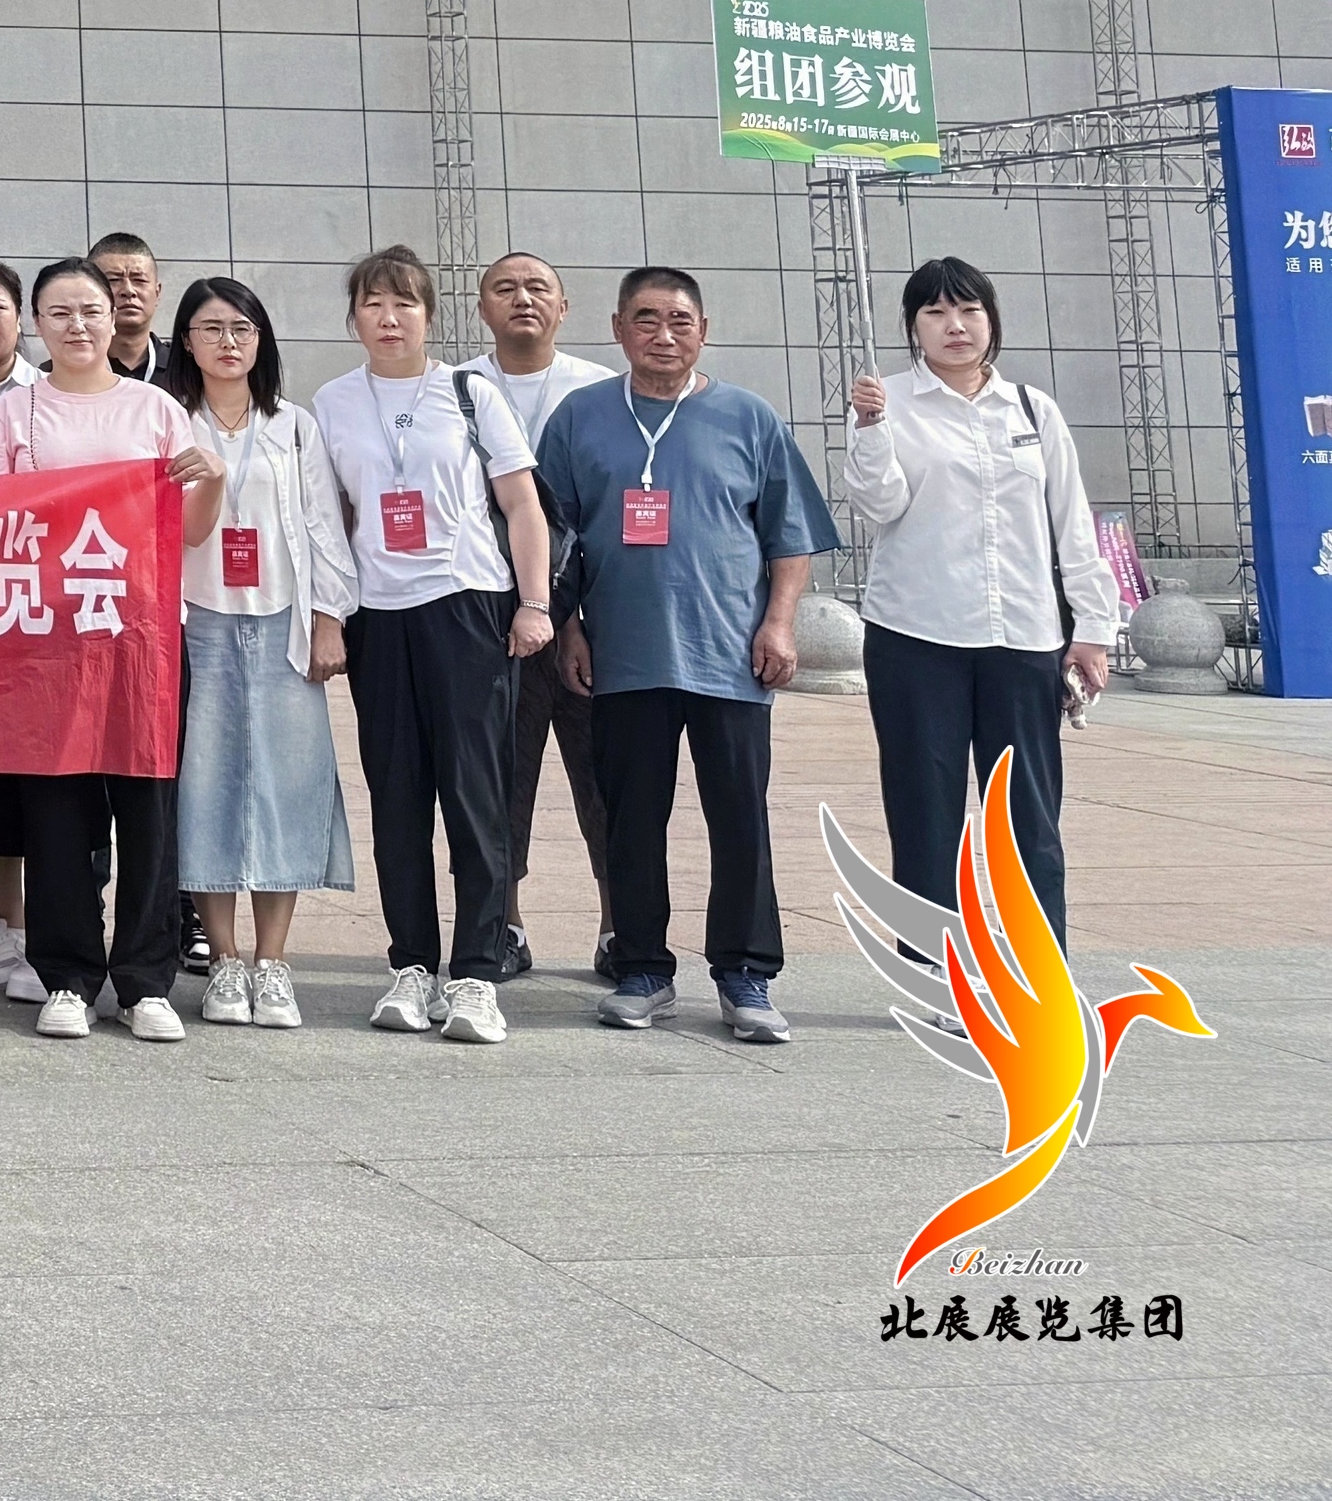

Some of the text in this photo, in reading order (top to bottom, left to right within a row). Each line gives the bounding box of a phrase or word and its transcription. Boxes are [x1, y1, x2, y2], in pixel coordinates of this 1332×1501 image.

[734, 16, 916, 53] 新疆粮油食品产业博览会
[733, 47, 921, 114] 组团参观
[837, 125, 921, 143] 新疆国际会展中心
[1286, 257, 1332, 273] 适用
[1301, 449, 1332, 464] 六面
